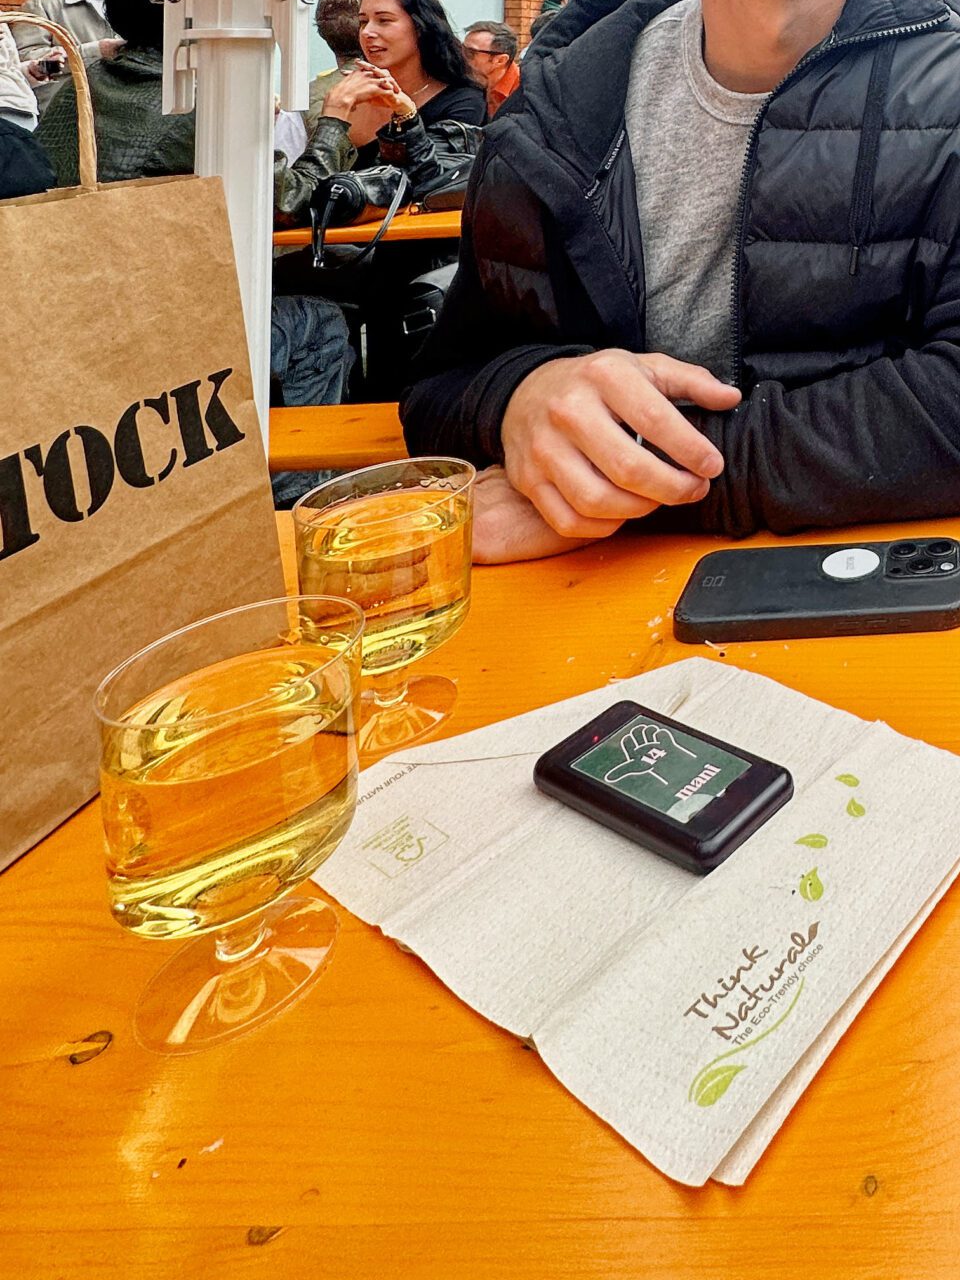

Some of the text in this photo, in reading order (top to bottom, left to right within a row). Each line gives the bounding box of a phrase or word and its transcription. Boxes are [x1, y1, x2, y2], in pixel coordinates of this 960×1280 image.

[674, 763, 722, 801] mani
[683, 944, 769, 1019] Think
[711, 920, 820, 1041] Natural
[731, 943, 824, 1046] The Eco-Trendy choice
